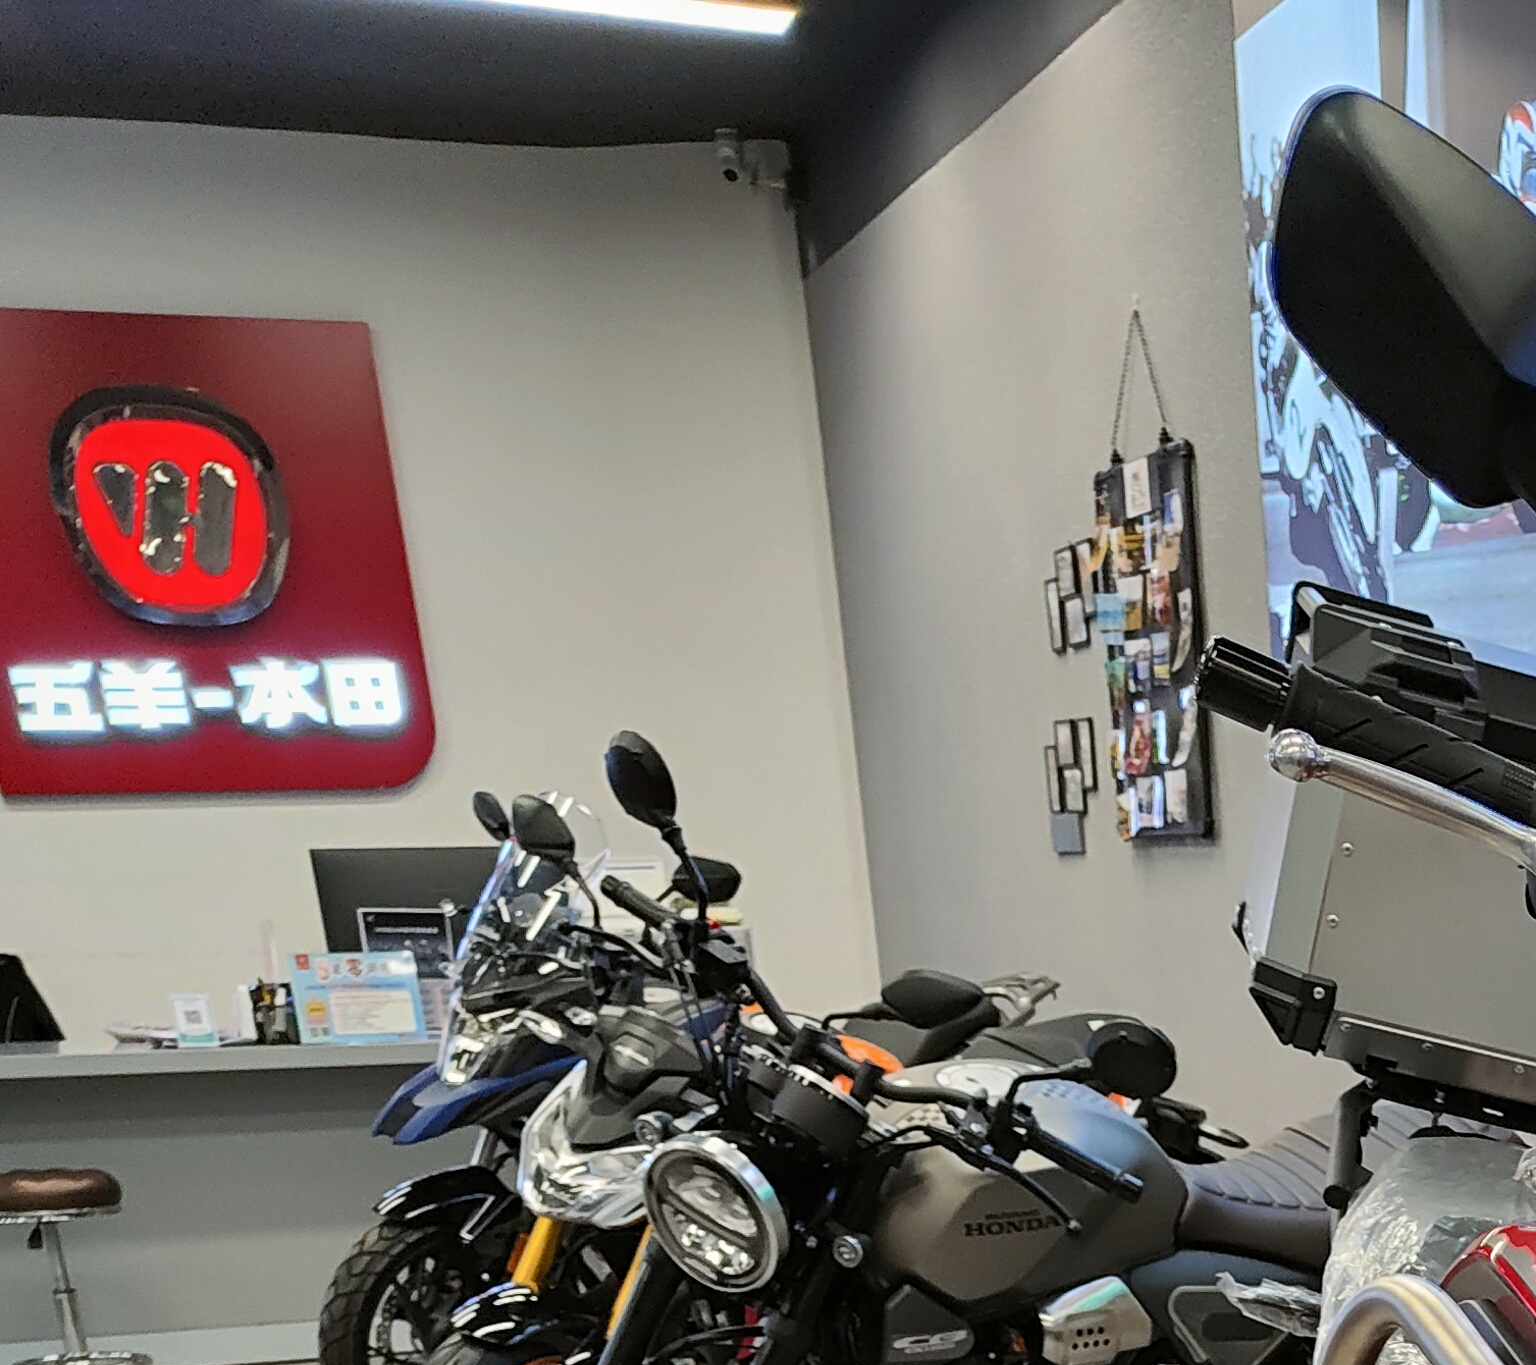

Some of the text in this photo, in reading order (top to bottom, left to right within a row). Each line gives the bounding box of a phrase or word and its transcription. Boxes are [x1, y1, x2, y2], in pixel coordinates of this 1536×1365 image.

[8, 657, 408, 736] 五羊-本田
[963, 1215, 1062, 1238] HONDA
